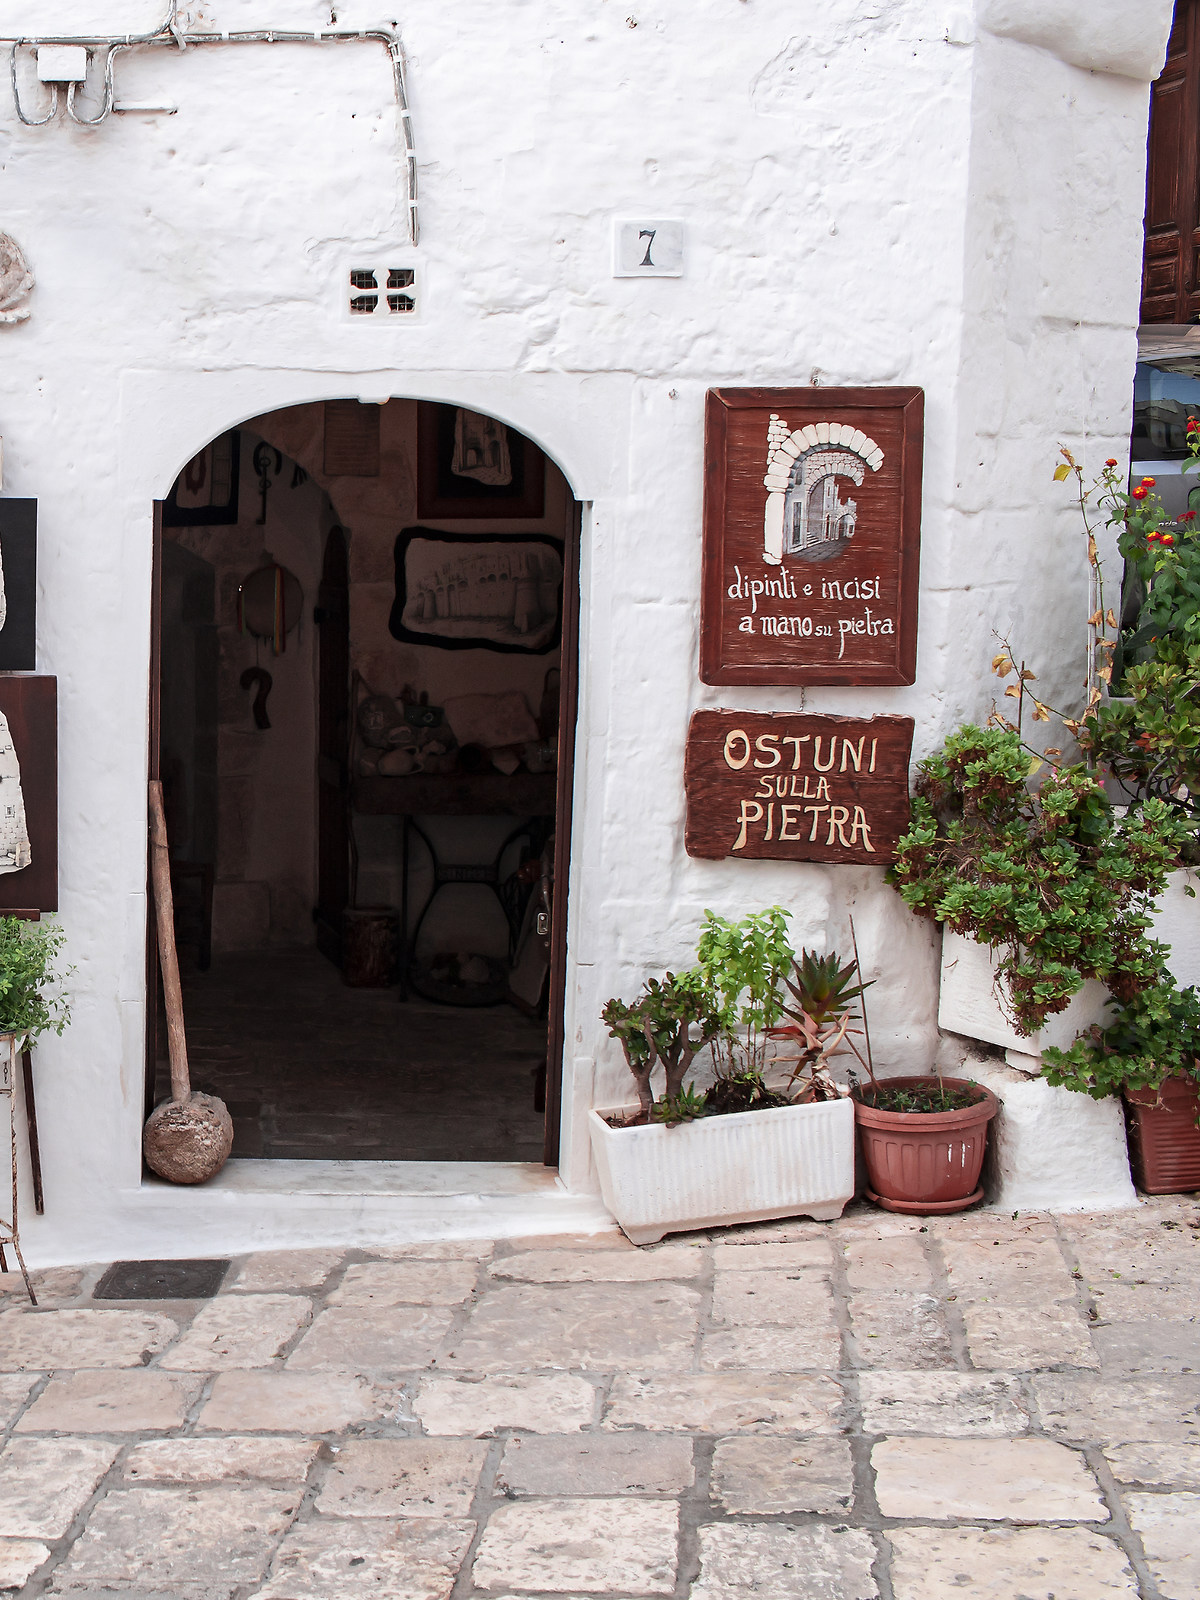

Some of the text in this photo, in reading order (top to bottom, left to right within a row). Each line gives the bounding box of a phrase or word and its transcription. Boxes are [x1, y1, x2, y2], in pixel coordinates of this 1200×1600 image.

[639, 229, 656, 266] 7
[727, 565, 881, 614] dipinti e incisi
[738, 607, 895, 660] a mano su pietra
[723, 728, 878, 773] OSTUNI
[754, 775, 832, 802] SULLA
[731, 799, 876, 852] PIETRA
